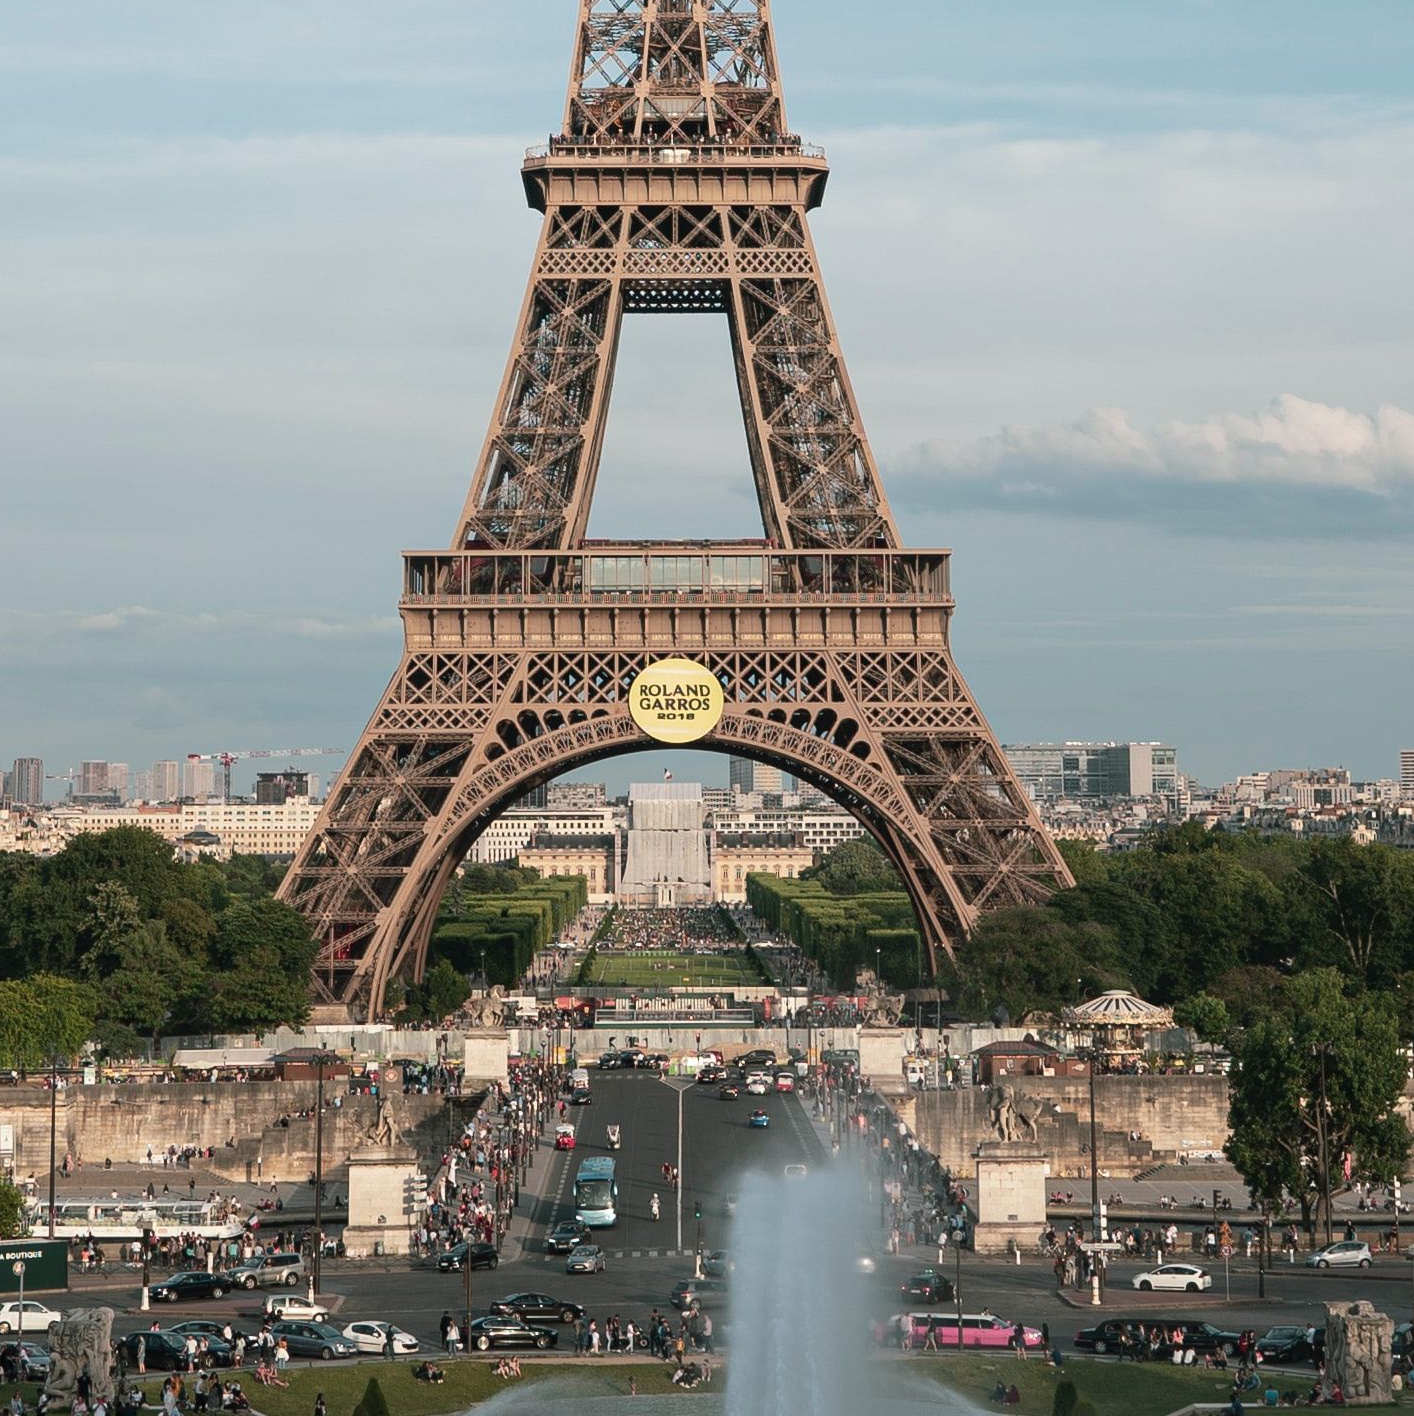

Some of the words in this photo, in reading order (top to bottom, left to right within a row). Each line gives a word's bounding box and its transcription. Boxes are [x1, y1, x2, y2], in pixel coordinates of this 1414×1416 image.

[639, 684, 710, 697] ROLAND
[639, 698, 710, 711] GARROS
[6, 1251, 43, 1260] BOUTIQUE
